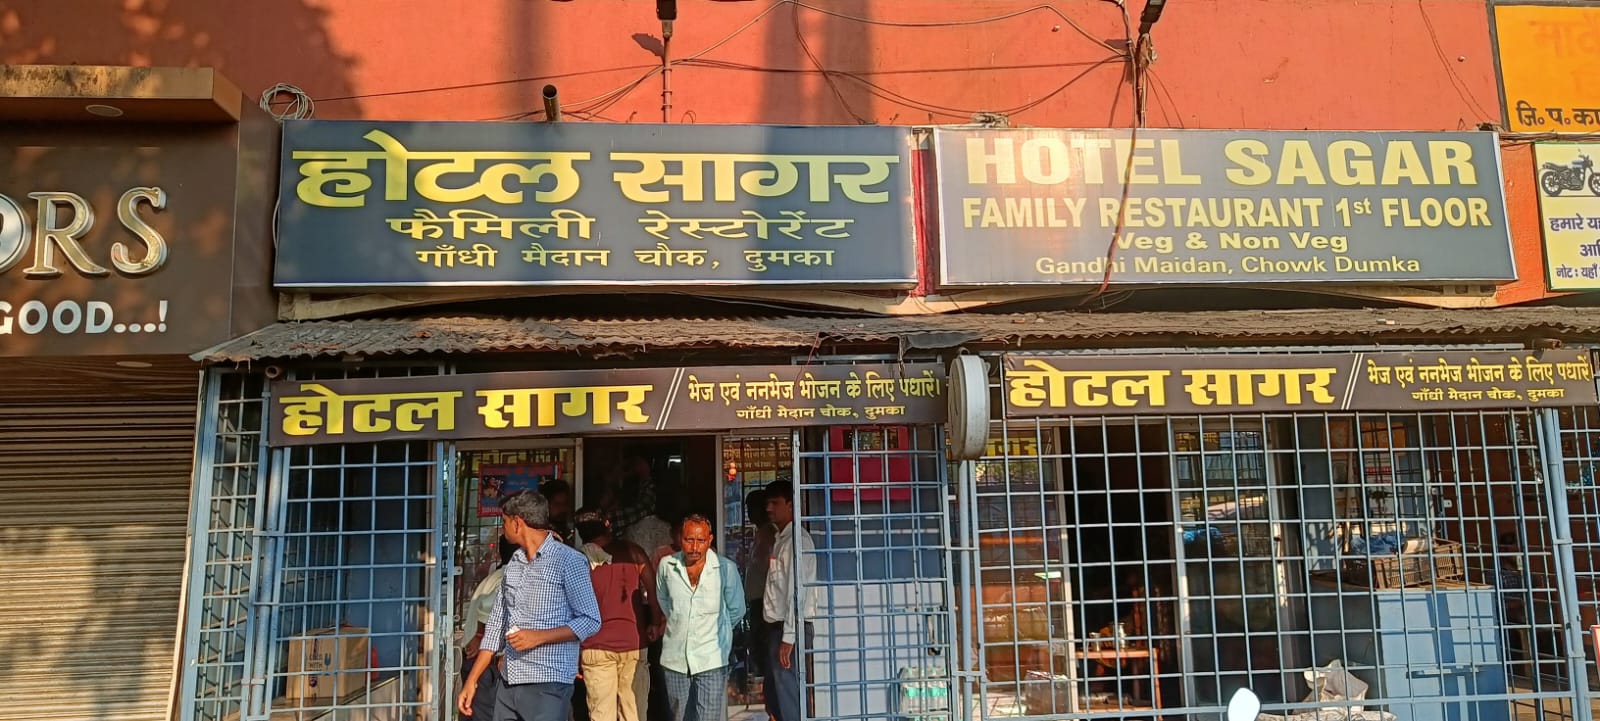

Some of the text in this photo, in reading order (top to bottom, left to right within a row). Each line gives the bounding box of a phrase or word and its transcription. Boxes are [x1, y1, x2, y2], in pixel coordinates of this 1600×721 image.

[292, 129, 900, 207] होटल सागर
[966, 137, 1478, 187] HOTEL SAGAR
[386, 208, 854, 241] फैमिली रेस्टोरेंट
[962, 197, 1492, 228] FAMILY RESTAURANT 1st FLOOR
[1548, 212, 1585, 232] हमारे
[416, 242, 835, 271] गाँधी मैदान चौक, दुमका
[1111, 232, 1348, 255] Veg & Non Veg
[1035, 256, 1421, 277] Gandhi Maidan, Chowk Dumka
[687, 374, 715, 402] भेज
[718, 373, 741, 406] एवं
[745, 372, 795, 401] ननभेज
[799, 371, 841, 400] भोजन
[845, 371, 862, 399] के
[865, 370, 896, 402] लिए
[1005, 359, 1338, 408] होटल सागर
[1366, 358, 1391, 385] भेज
[1394, 358, 1415, 389] एवं
[1418, 357, 1463, 384] ननभेज
[1466, 356, 1505, 383] भोजन
[1507, 355, 1524, 382] के
[1525, 355, 1555, 385] लिए
[279, 383, 654, 437] होटल सागर
[1526, 388, 1566, 403] दुमका
[863, 404, 906, 420] दुमका
